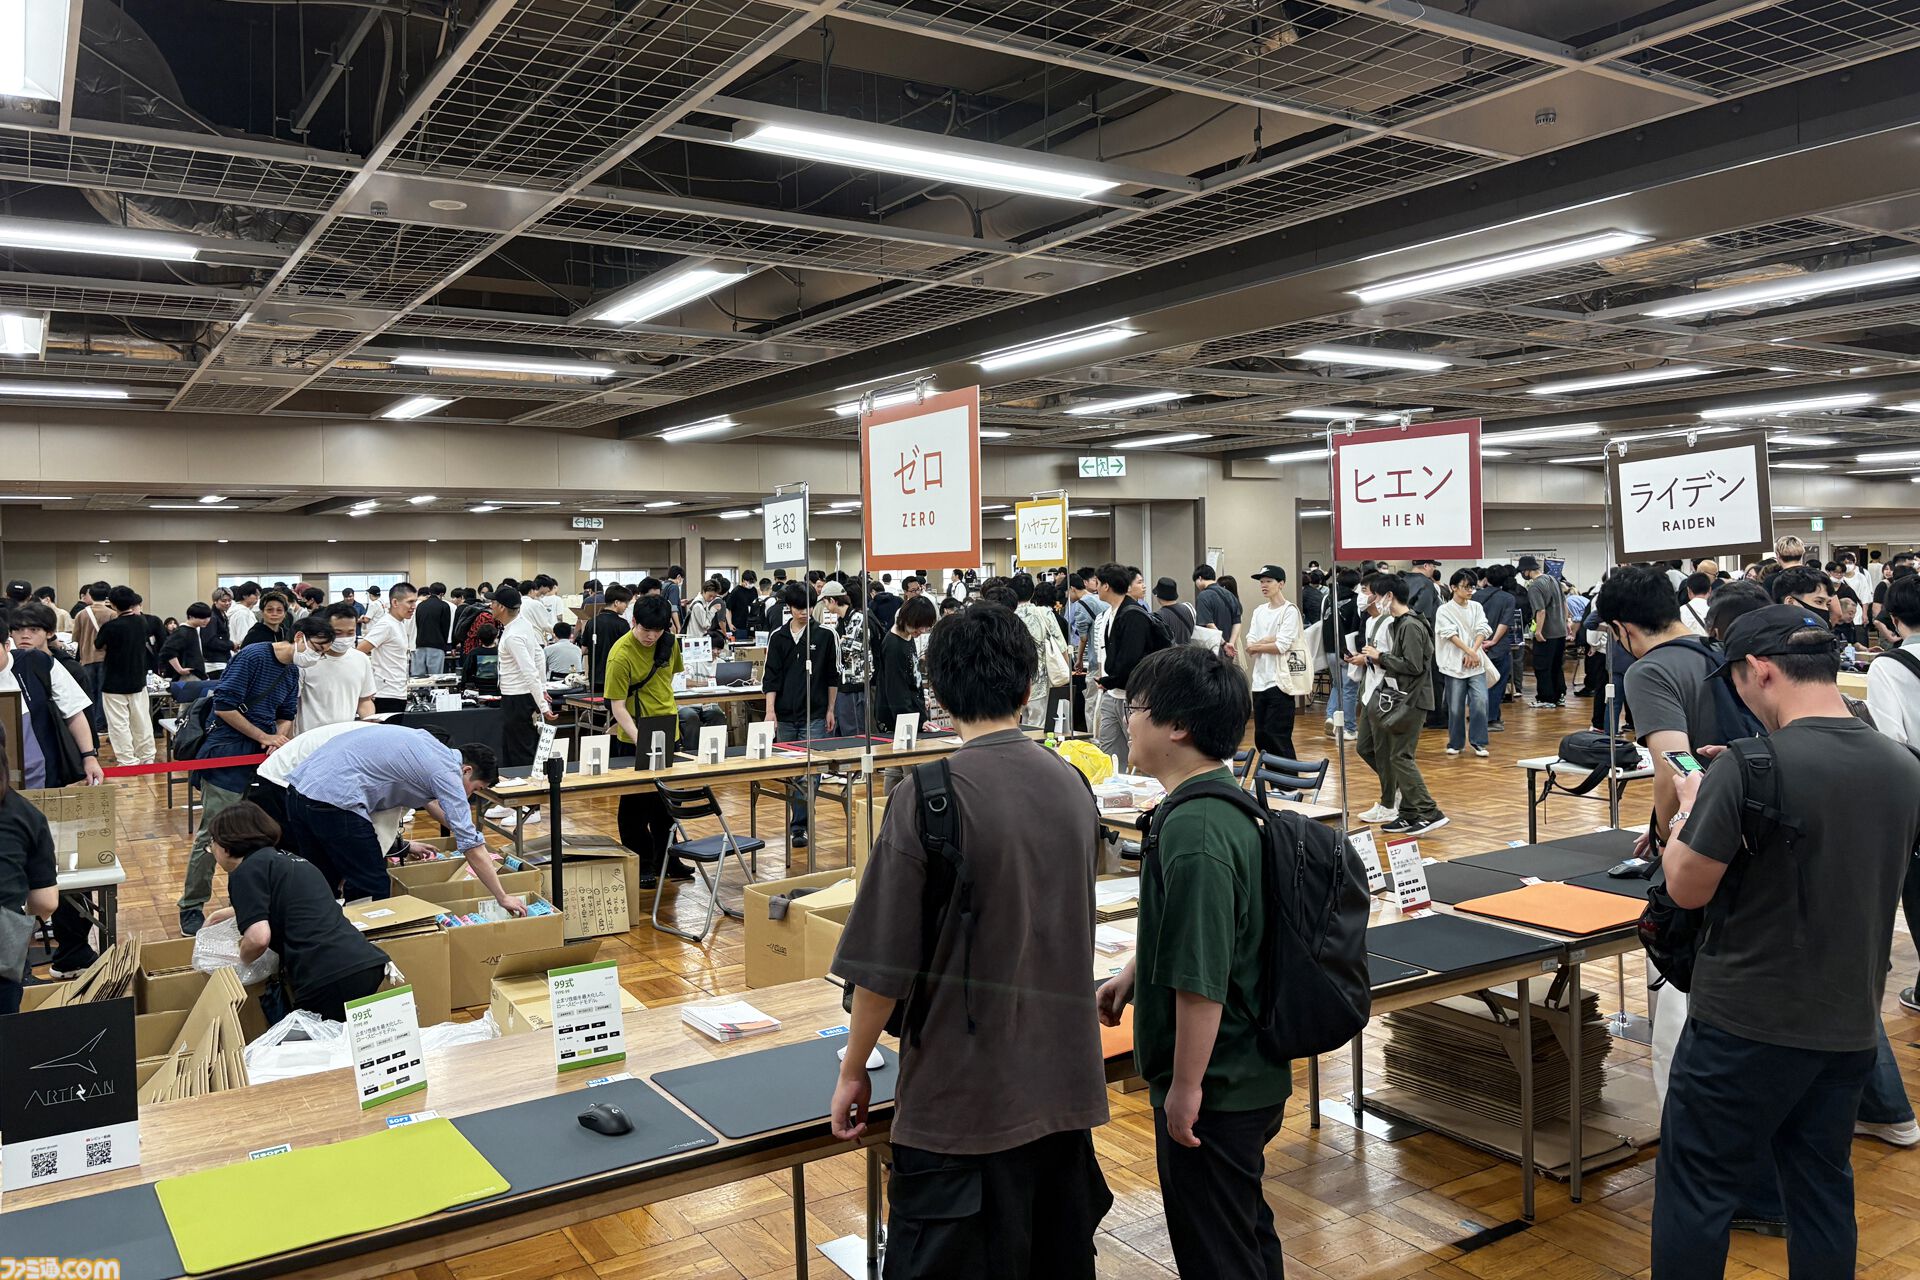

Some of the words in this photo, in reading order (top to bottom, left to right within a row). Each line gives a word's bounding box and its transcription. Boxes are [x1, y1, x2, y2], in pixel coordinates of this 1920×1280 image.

[894, 444, 943, 494] ゼロ
[1354, 465, 1453, 503] ヒエン
[1630, 470, 1745, 513] ライデン
[772, 513, 796, 536] キ83
[902, 511, 936, 528] ZERO
[1021, 517, 1060, 536] ハヤテ乙
[1382, 513, 1425, 527] HIEN
[1661, 516, 1716, 532] RAIDEN
[554, 977, 575, 990] 99式
[352, 1008, 373, 1022] 99式
[388, 1116, 409, 1125] SOFT
